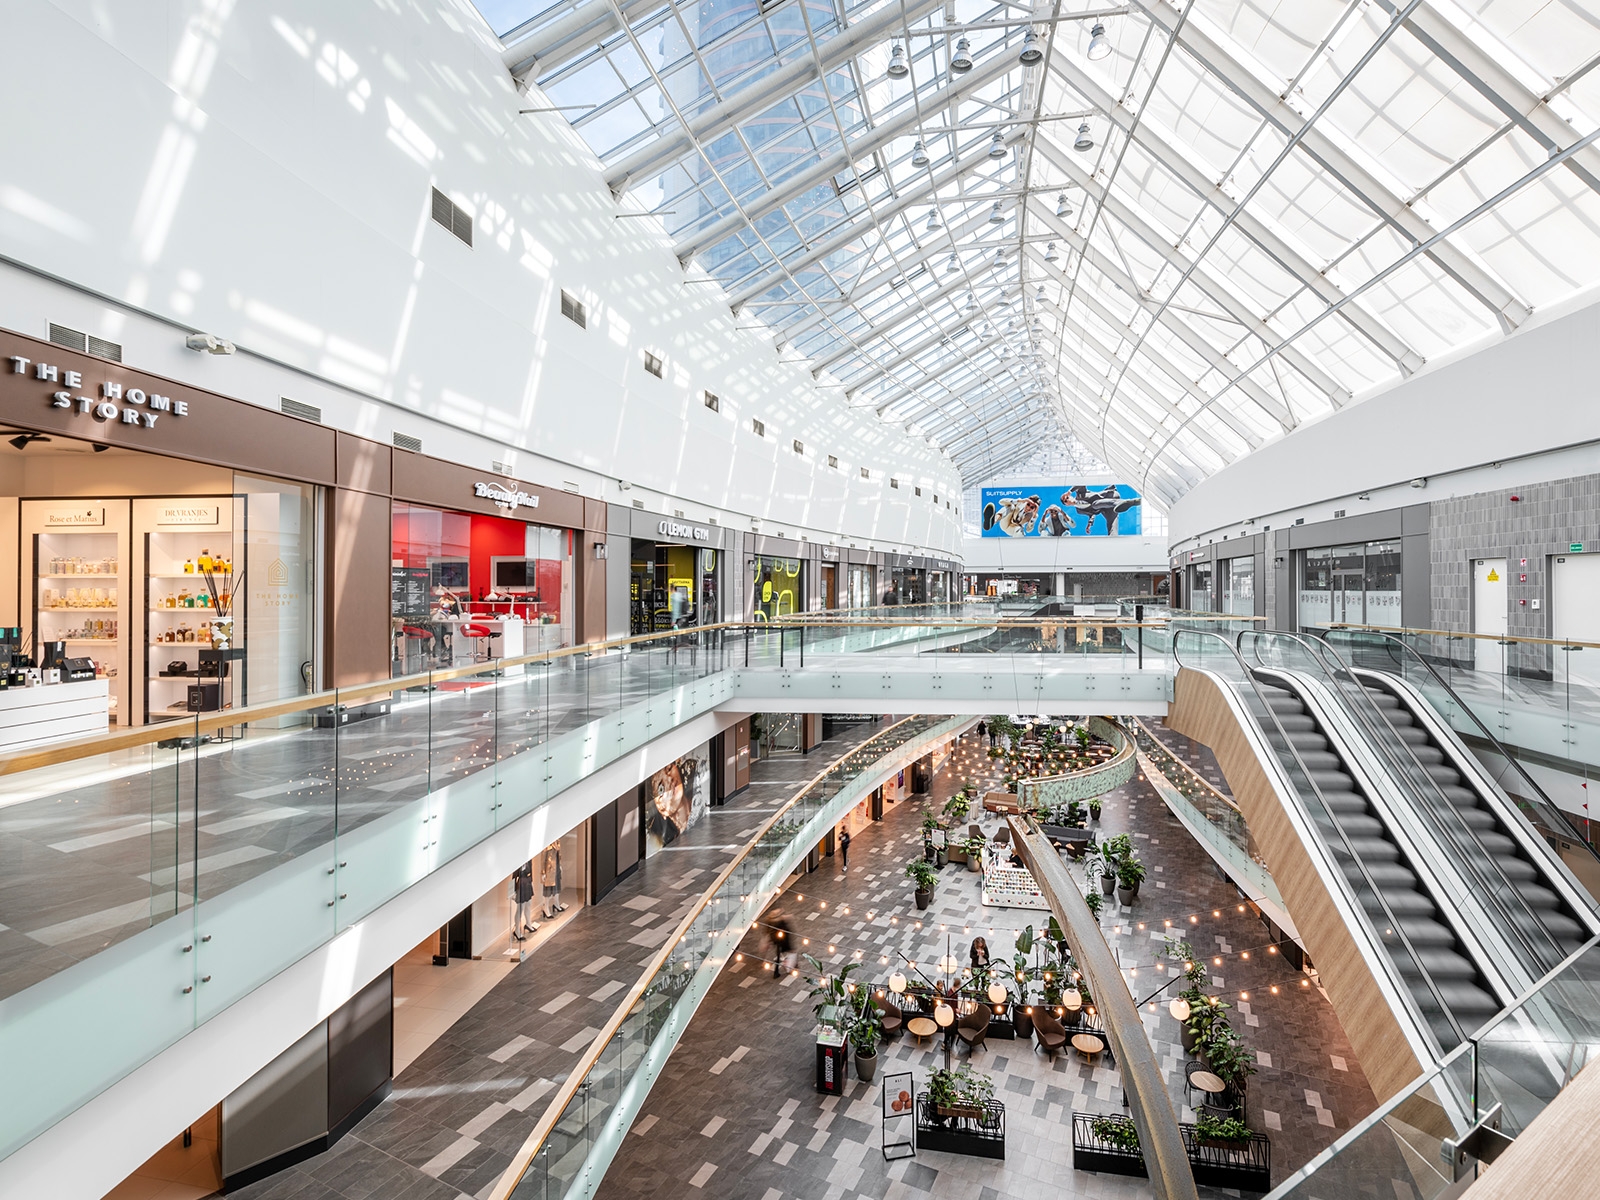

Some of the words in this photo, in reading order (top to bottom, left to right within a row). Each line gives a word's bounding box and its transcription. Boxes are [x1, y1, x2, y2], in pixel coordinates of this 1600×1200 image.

[10, 355, 82, 389] THE
[104, 381, 189, 417] HOME
[53, 391, 159, 429] STORY
[667, 522, 693, 538] LEMON
[693, 527, 709, 541] GYM
